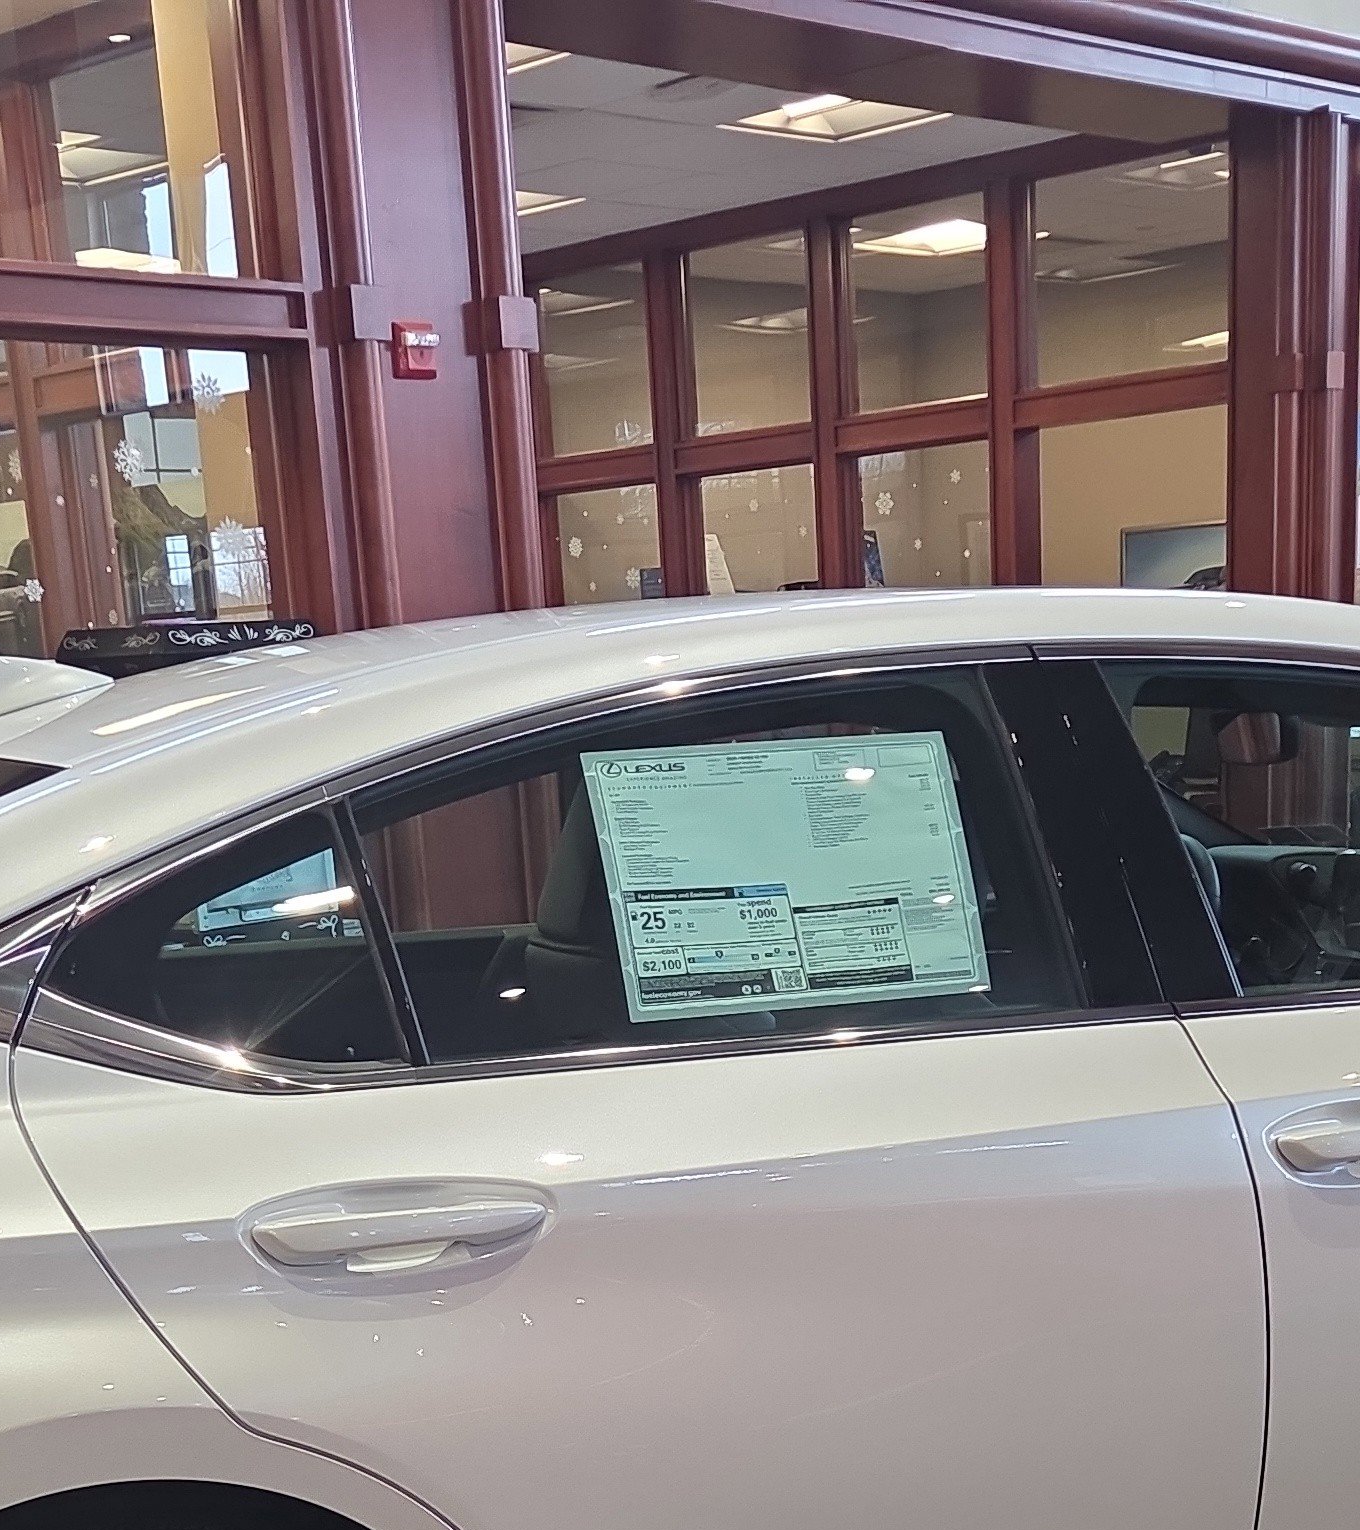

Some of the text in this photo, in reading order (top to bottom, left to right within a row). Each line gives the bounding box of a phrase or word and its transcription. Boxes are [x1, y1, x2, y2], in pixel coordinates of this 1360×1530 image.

[623, 761, 686, 774] LEXUS
[639, 910, 667, 931] 25
[739, 907, 778, 921] $1,000
[642, 959, 682, 973] $2,100
